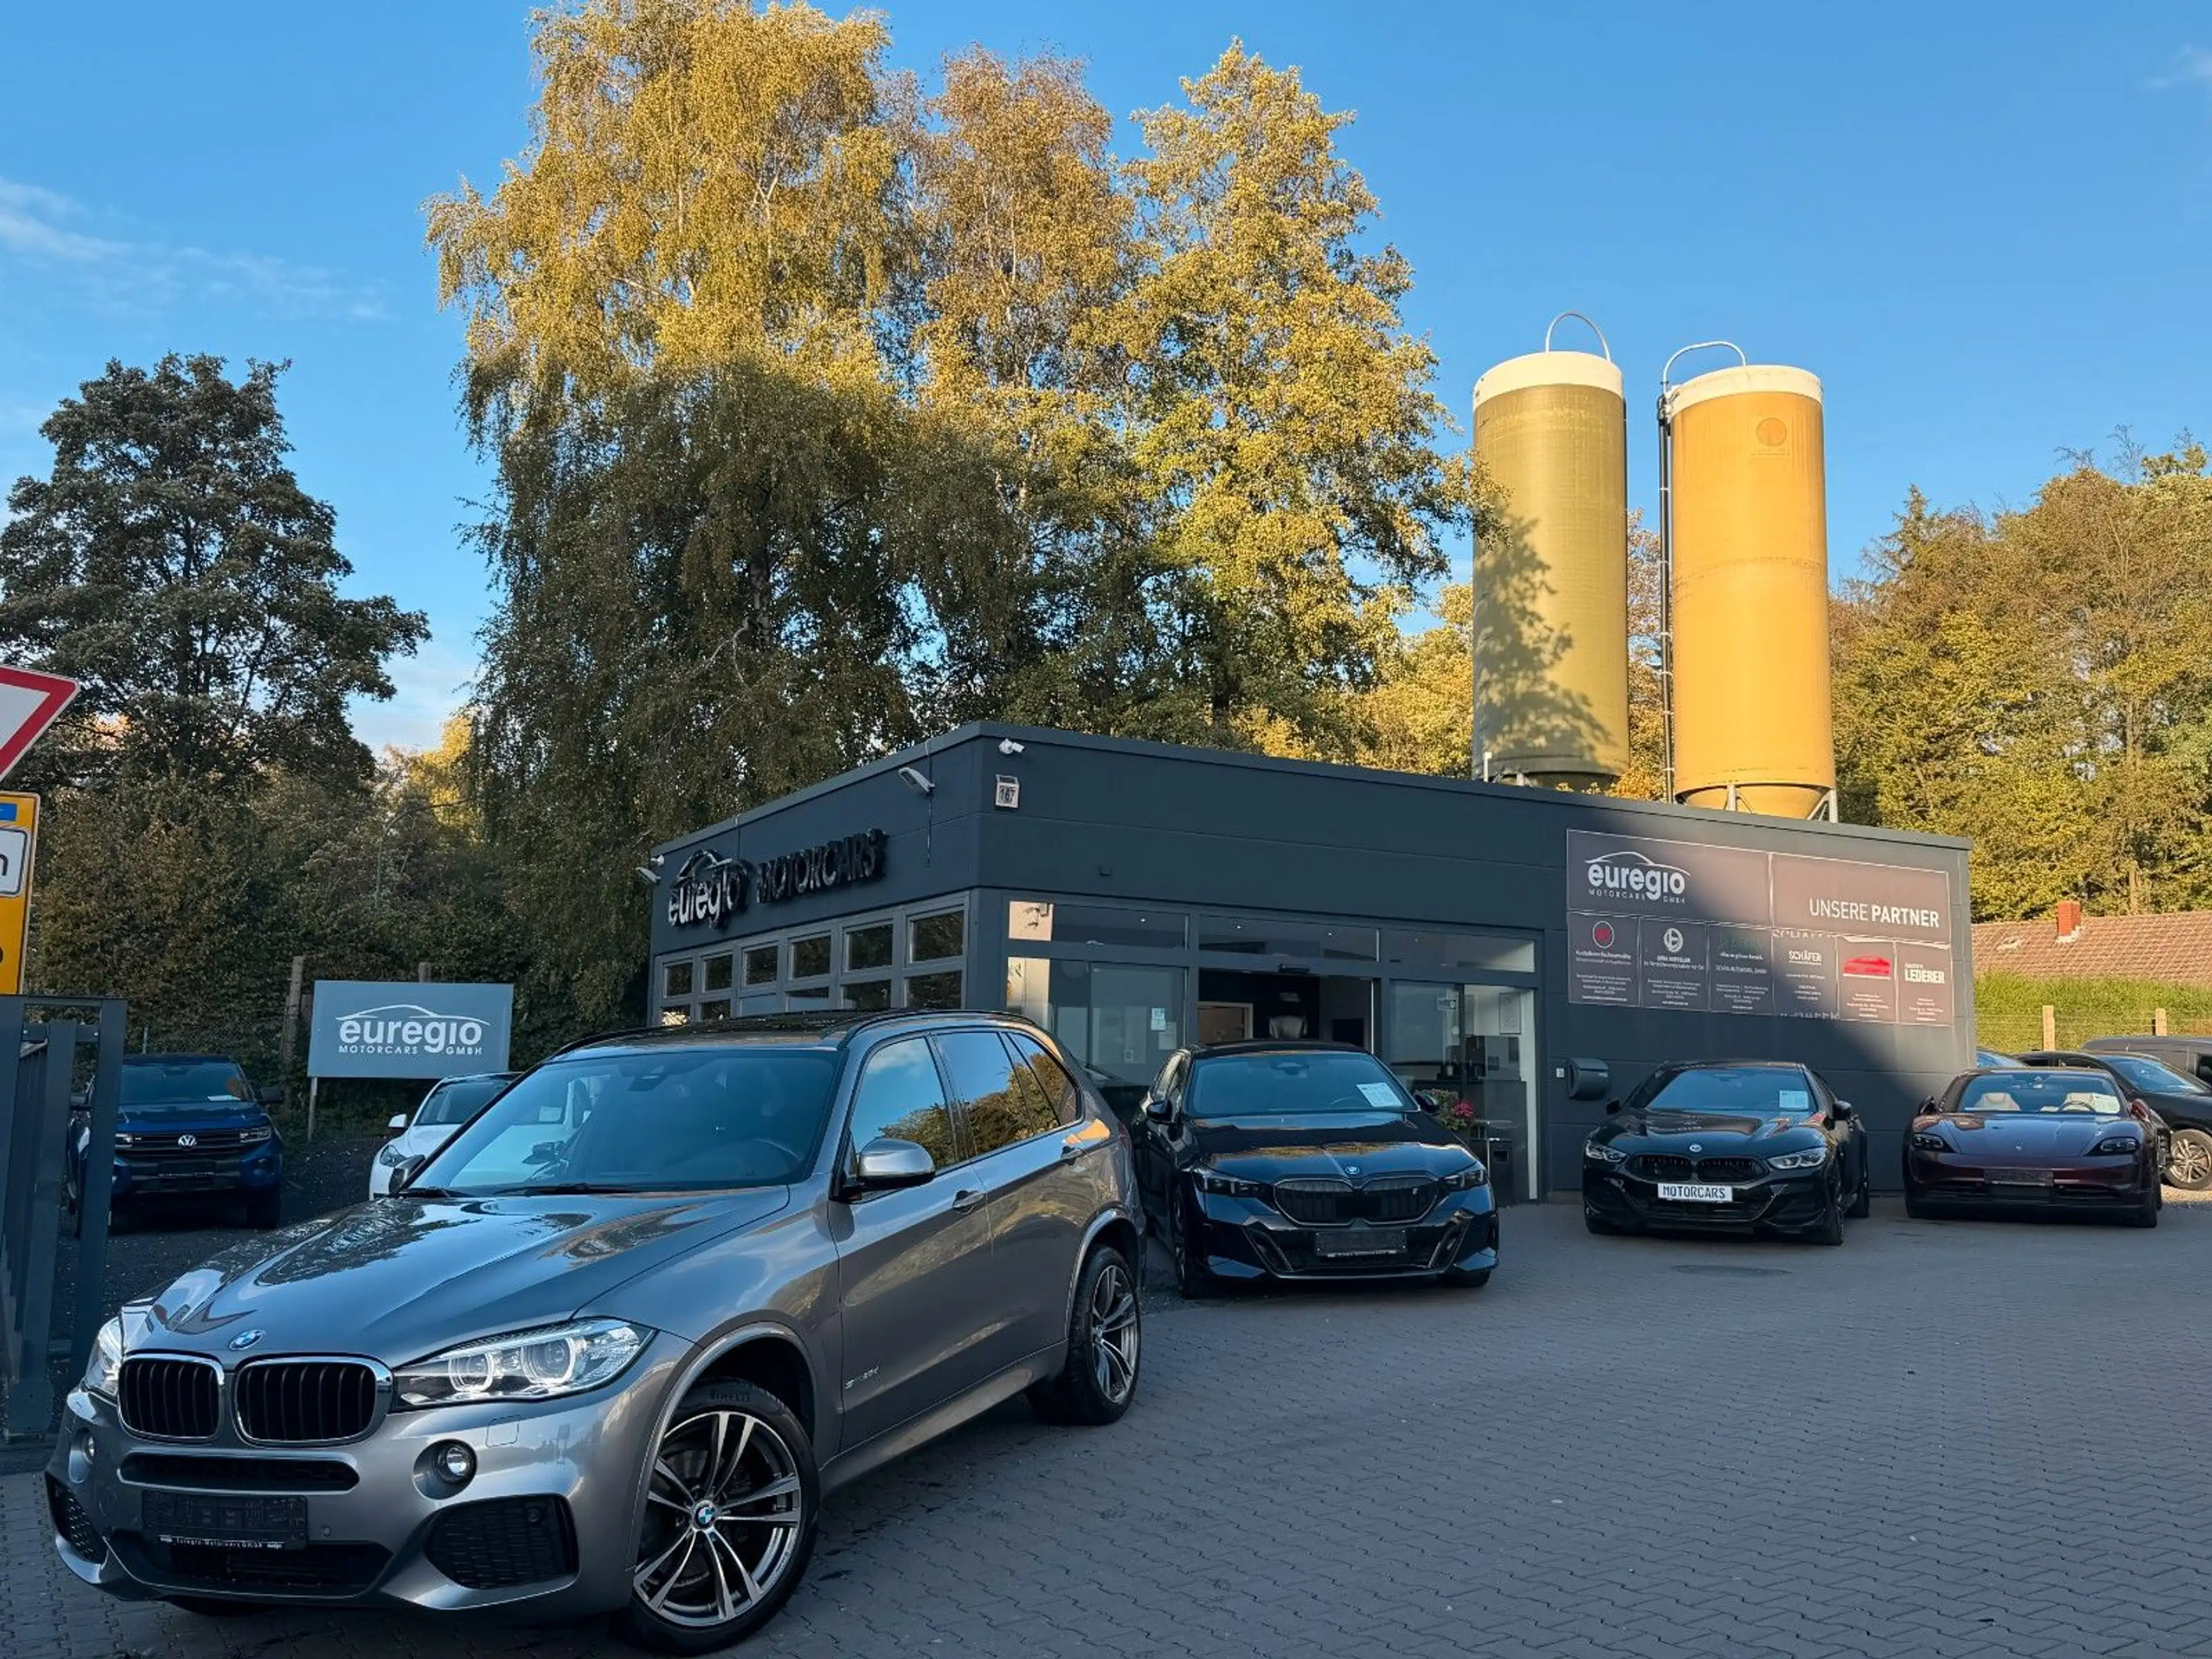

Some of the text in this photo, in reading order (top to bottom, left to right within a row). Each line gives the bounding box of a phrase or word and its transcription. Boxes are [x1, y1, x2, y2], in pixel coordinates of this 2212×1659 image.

[1588, 864, 1685, 900] euregio
[1809, 897, 1940, 928] UNSERE PARTNER
[339, 1020, 482, 1053] euregio
[339, 1046, 482, 1055] MOTORCARS GMBH
[1663, 1185, 1725, 1199] MOTORCARS
